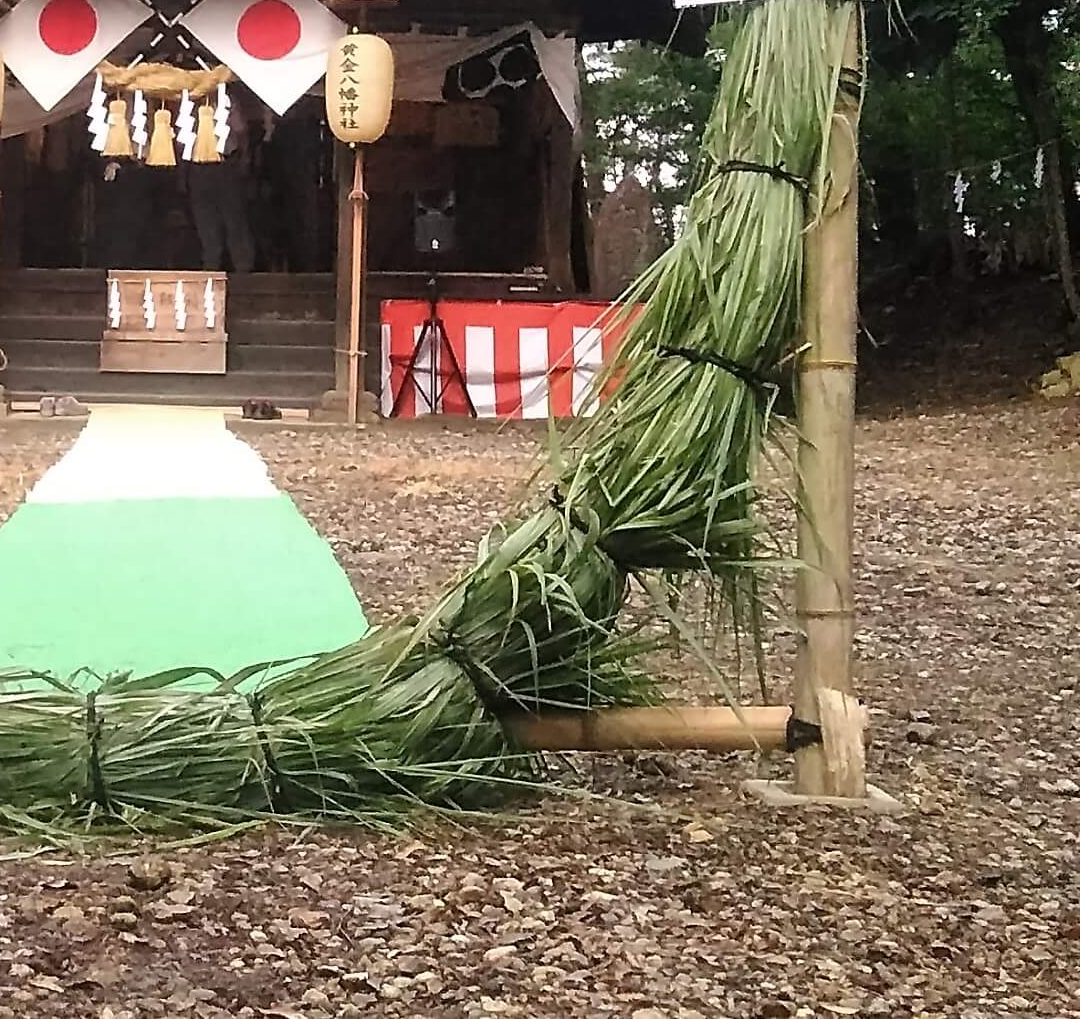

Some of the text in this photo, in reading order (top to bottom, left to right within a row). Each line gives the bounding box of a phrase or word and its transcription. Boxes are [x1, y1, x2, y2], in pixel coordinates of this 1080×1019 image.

[339, 43, 360, 129] 黄金八幡神社
